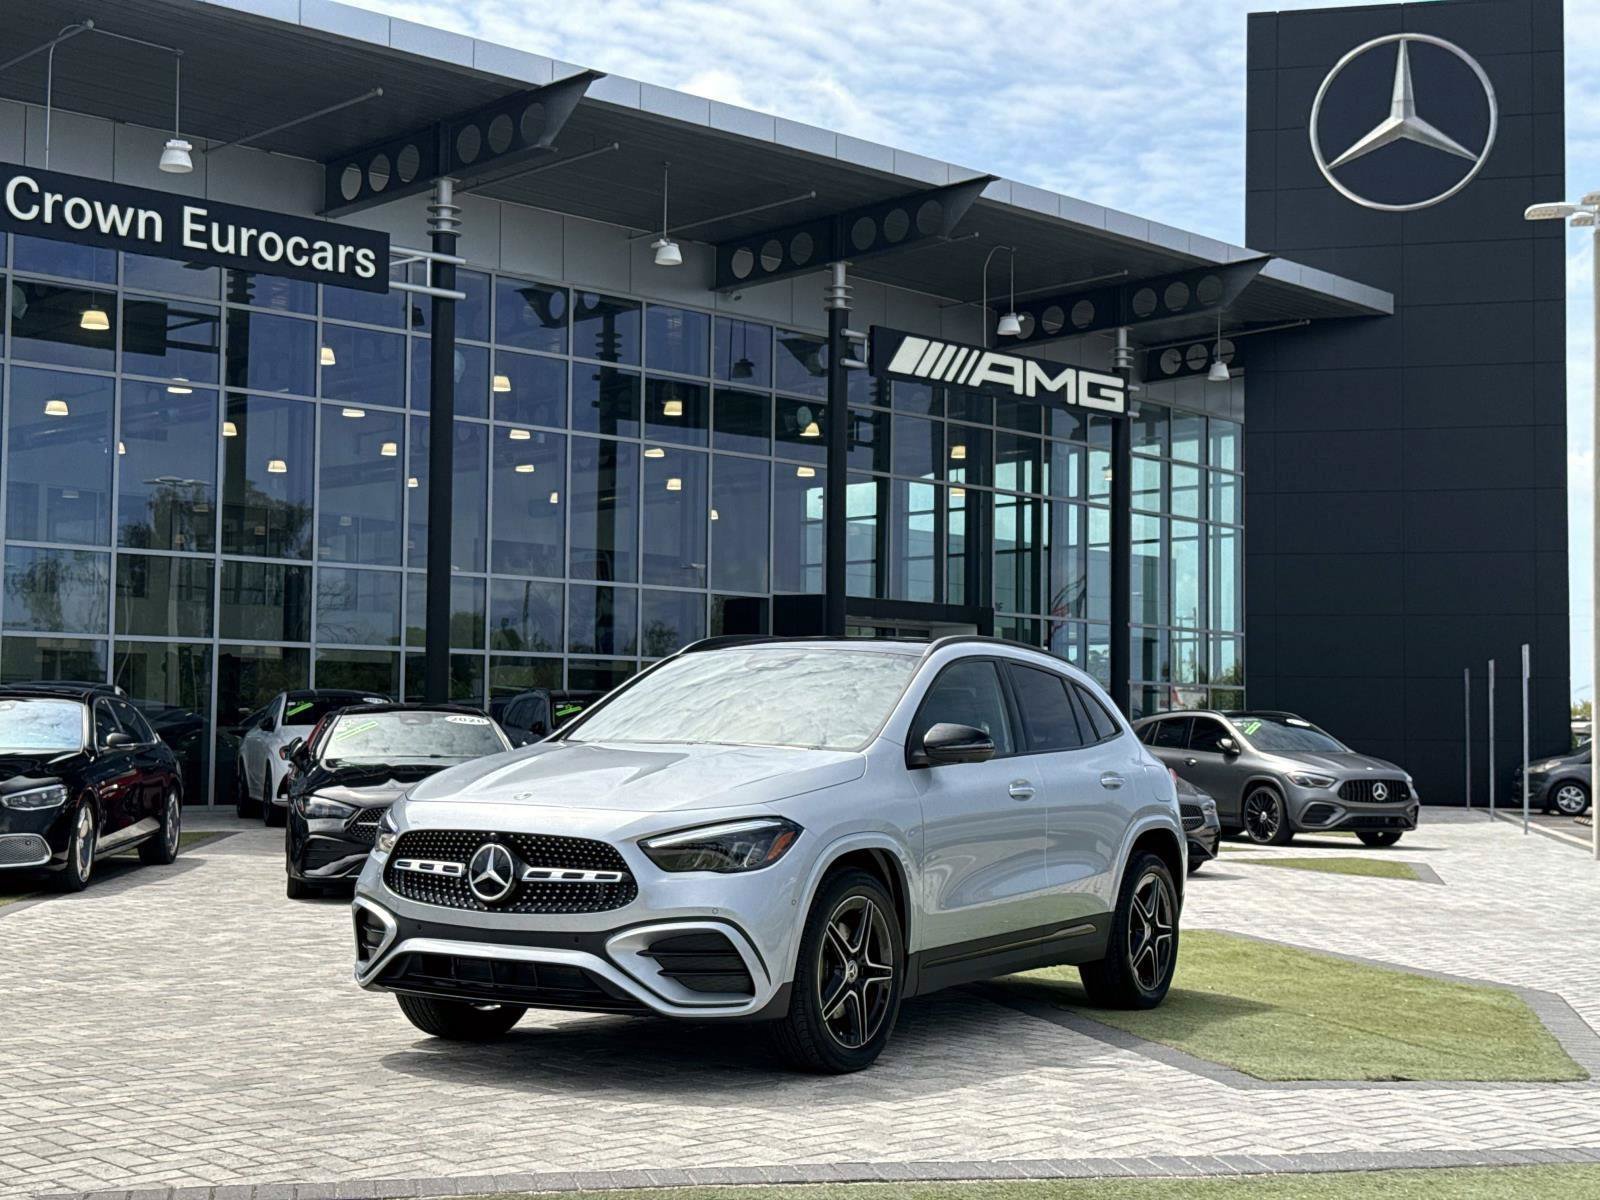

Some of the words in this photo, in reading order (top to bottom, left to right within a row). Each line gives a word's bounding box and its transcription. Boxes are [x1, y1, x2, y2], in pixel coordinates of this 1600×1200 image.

[5, 175, 163, 242] Crown
[183, 205, 376, 278] Eurocars
[967, 351, 1124, 413] AMG
